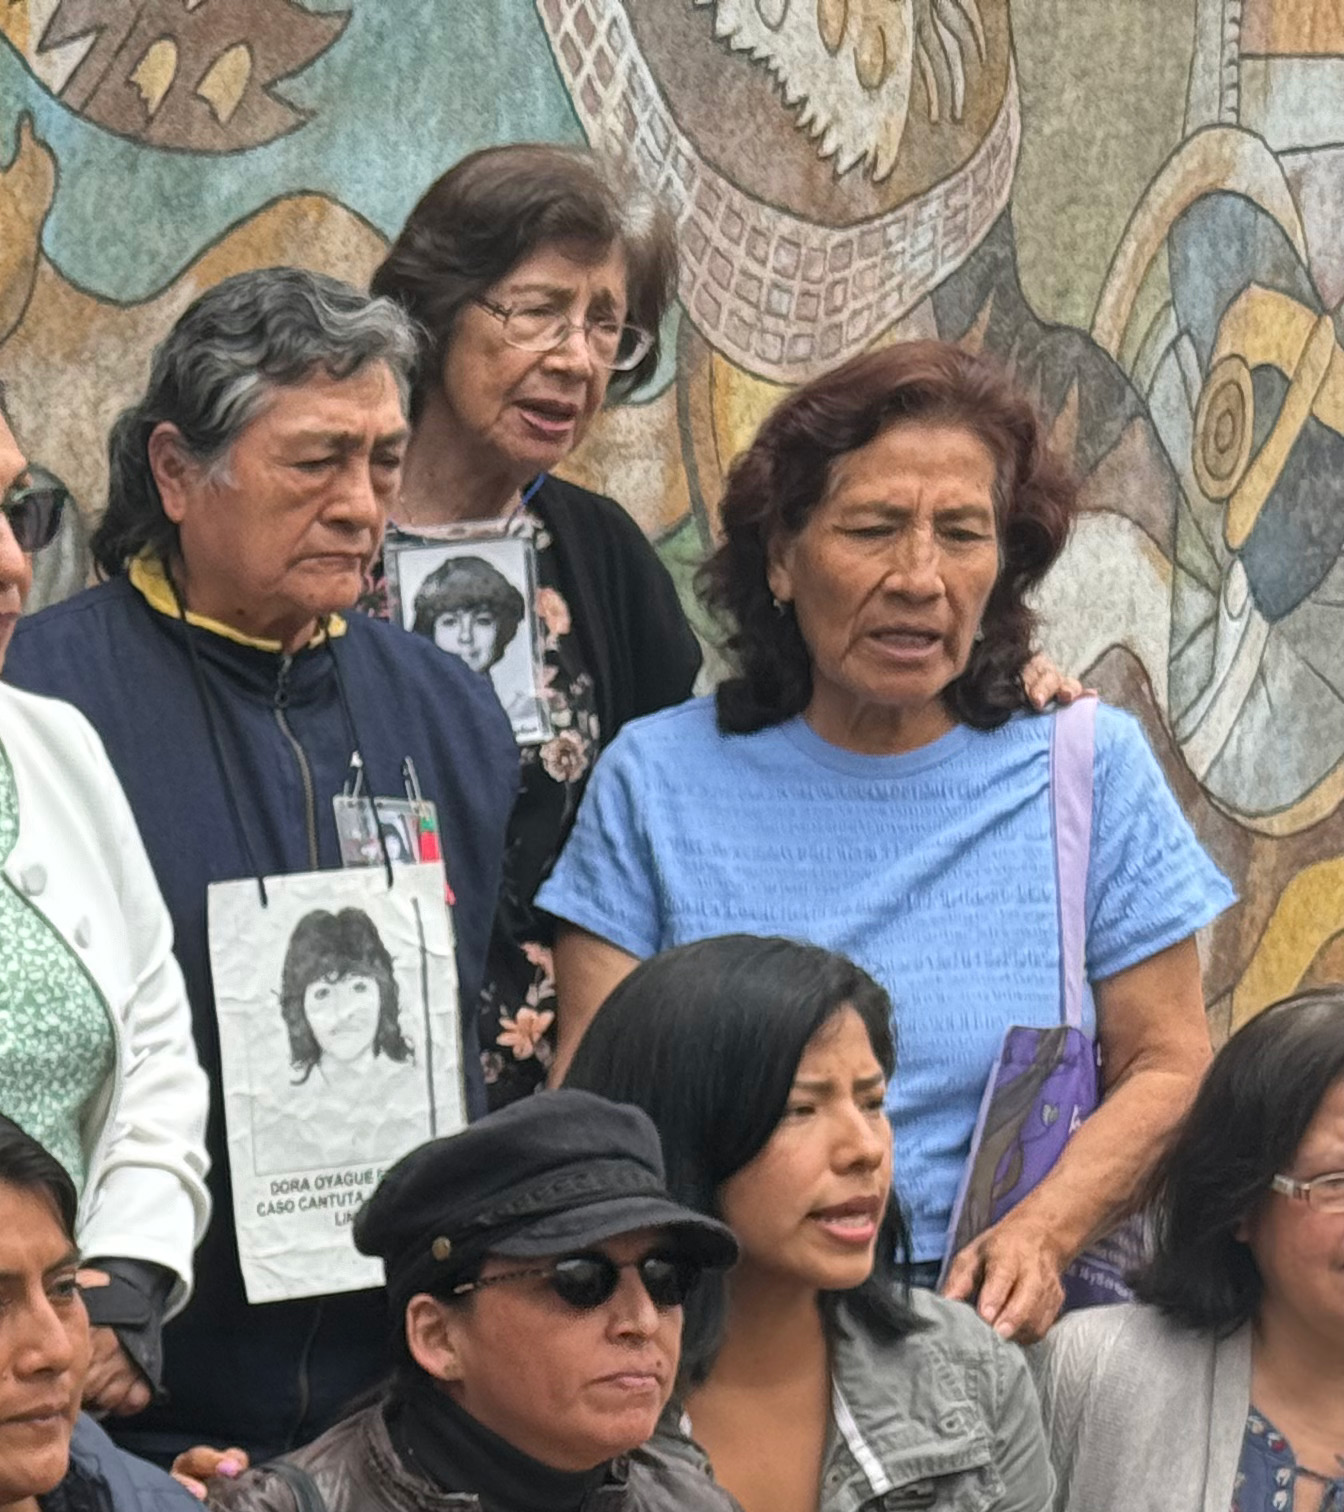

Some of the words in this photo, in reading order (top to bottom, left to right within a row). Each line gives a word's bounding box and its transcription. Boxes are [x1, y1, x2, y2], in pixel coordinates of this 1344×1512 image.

[270, 1177, 310, 1197] DORA
[314, 1171, 375, 1191] OYAGUE
[256, 1199, 295, 1217] CASO
[298, 1191, 363, 1212] CANTUTA
